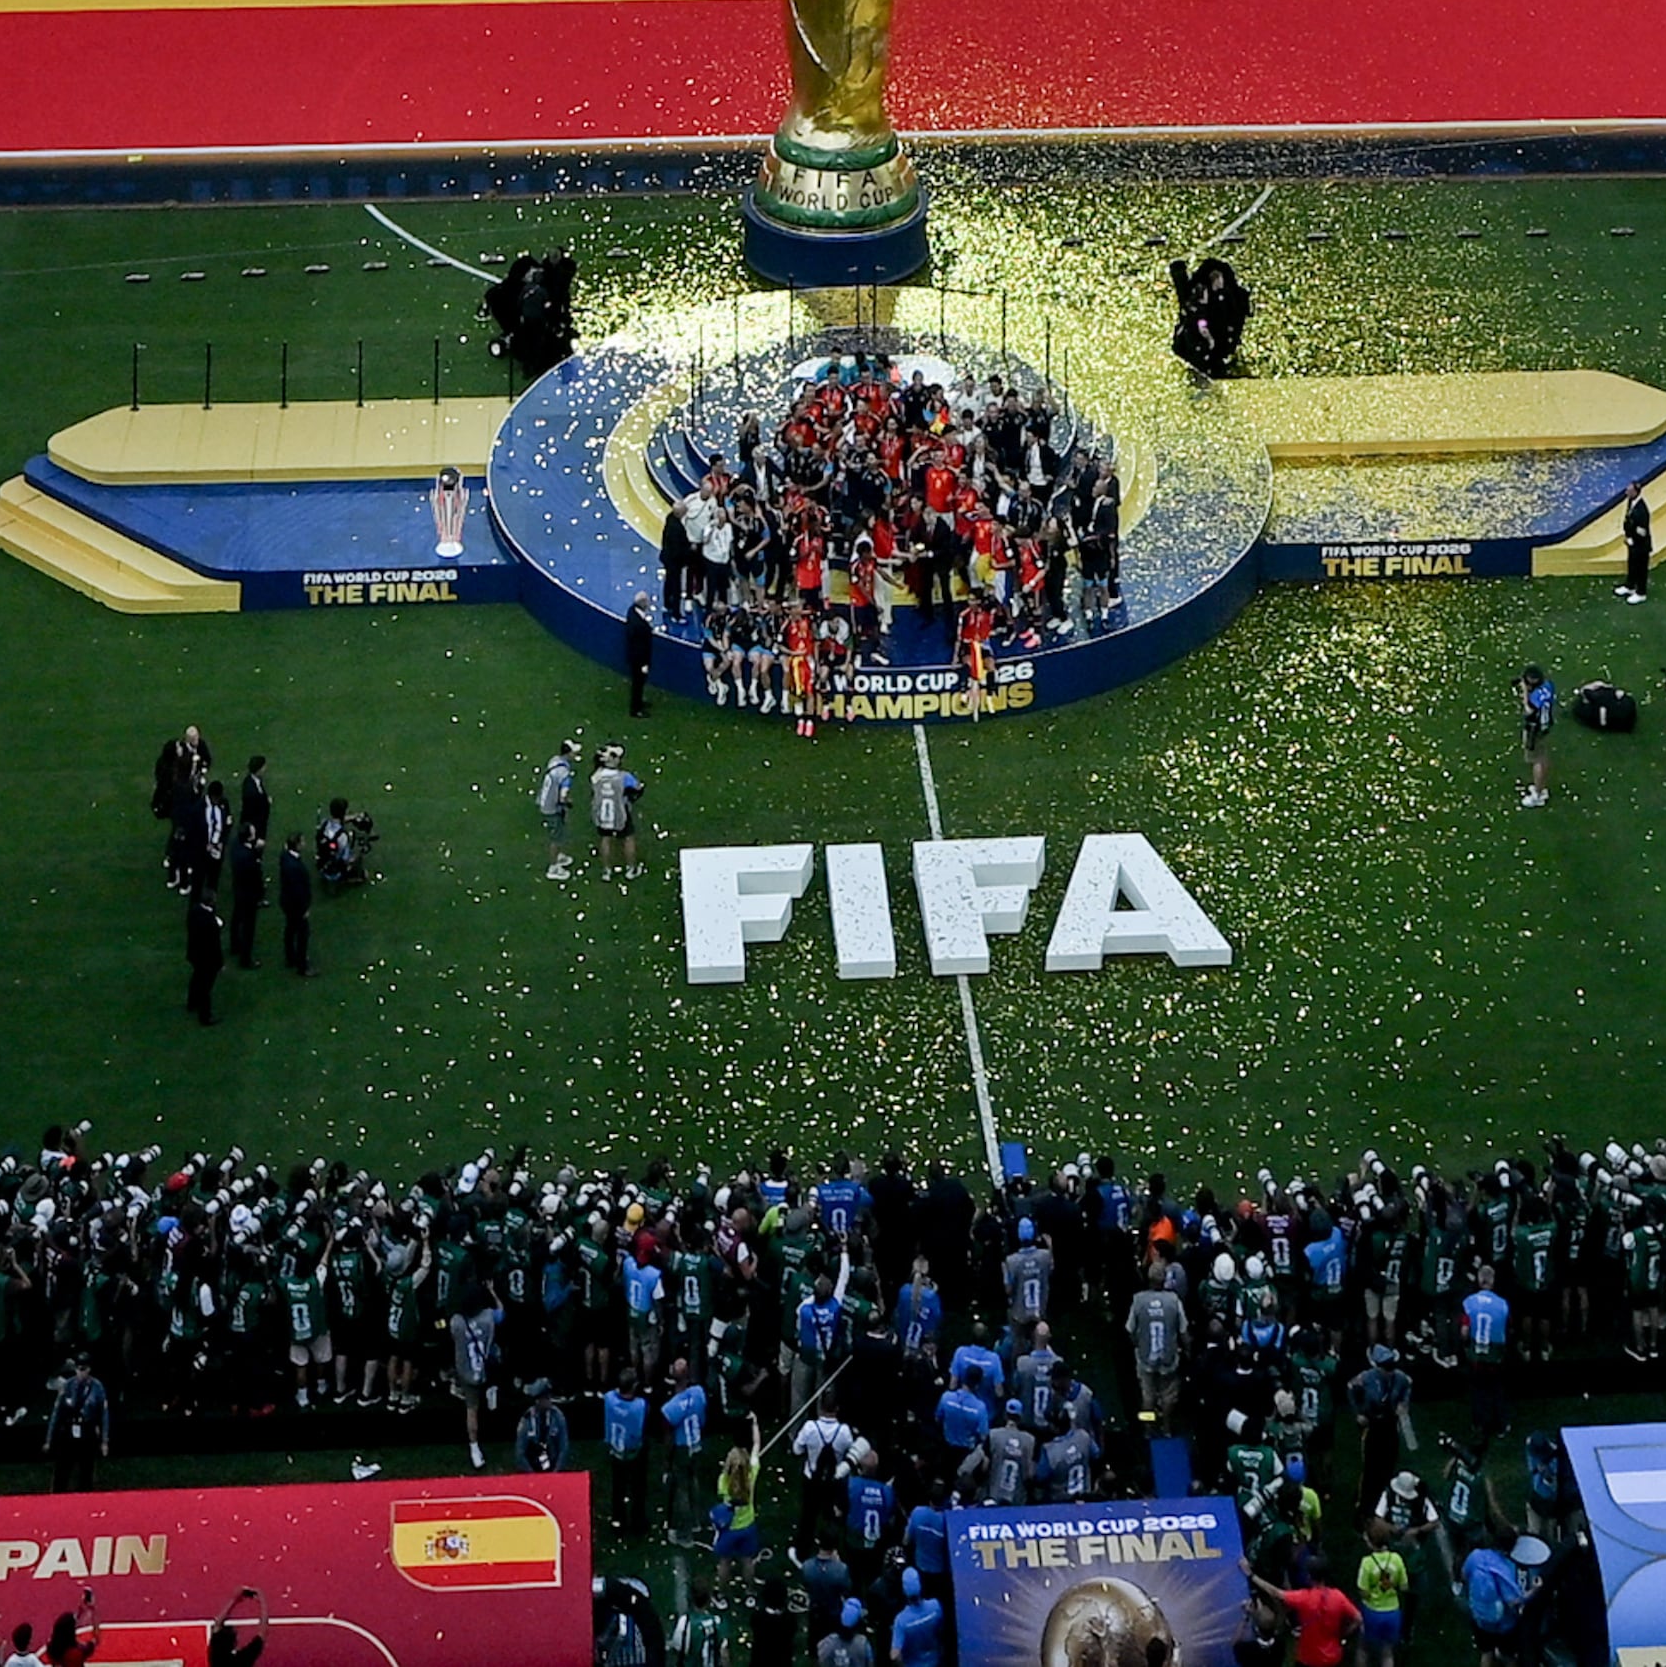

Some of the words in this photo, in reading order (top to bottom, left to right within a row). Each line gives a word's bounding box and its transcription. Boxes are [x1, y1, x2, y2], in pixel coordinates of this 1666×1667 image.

[792, 167, 876, 189] FIFA
[780, 185, 848, 211] WORLD
[859, 186, 895, 209] CUP
[1321, 546, 1349, 558] FIFA
[1351, 545, 1397, 558] WORLD
[1399, 544, 1425, 556] CUP
[1427, 543, 1471, 555] 2026
[303, 573, 332, 585] FIFA
[333, 572, 382, 584] WORLD
[383, 570, 410, 582] CUP
[411, 569, 458, 581] 2026
[1322, 557, 1379, 577] THE
[1385, 554, 1471, 577] FINAL
[304, 584, 364, 605] THE
[370, 582, 458, 603] FINAL
[833, 674, 913, 693] WORLD
[915, 672, 959, 691] CUP
[825, 681, 1034, 721] HAMPIONS
[679, 832, 1232, 986] FIFA
[969, 1523, 1015, 1540] FIFA
[1019, 1519, 1096, 1538] WORLD
[1097, 1517, 1139, 1535] CUP
[1143, 1514, 1217, 1533] 2026
[971, 1537, 1069, 1570] THE
[1077, 1531, 1222, 1566] FINAL
